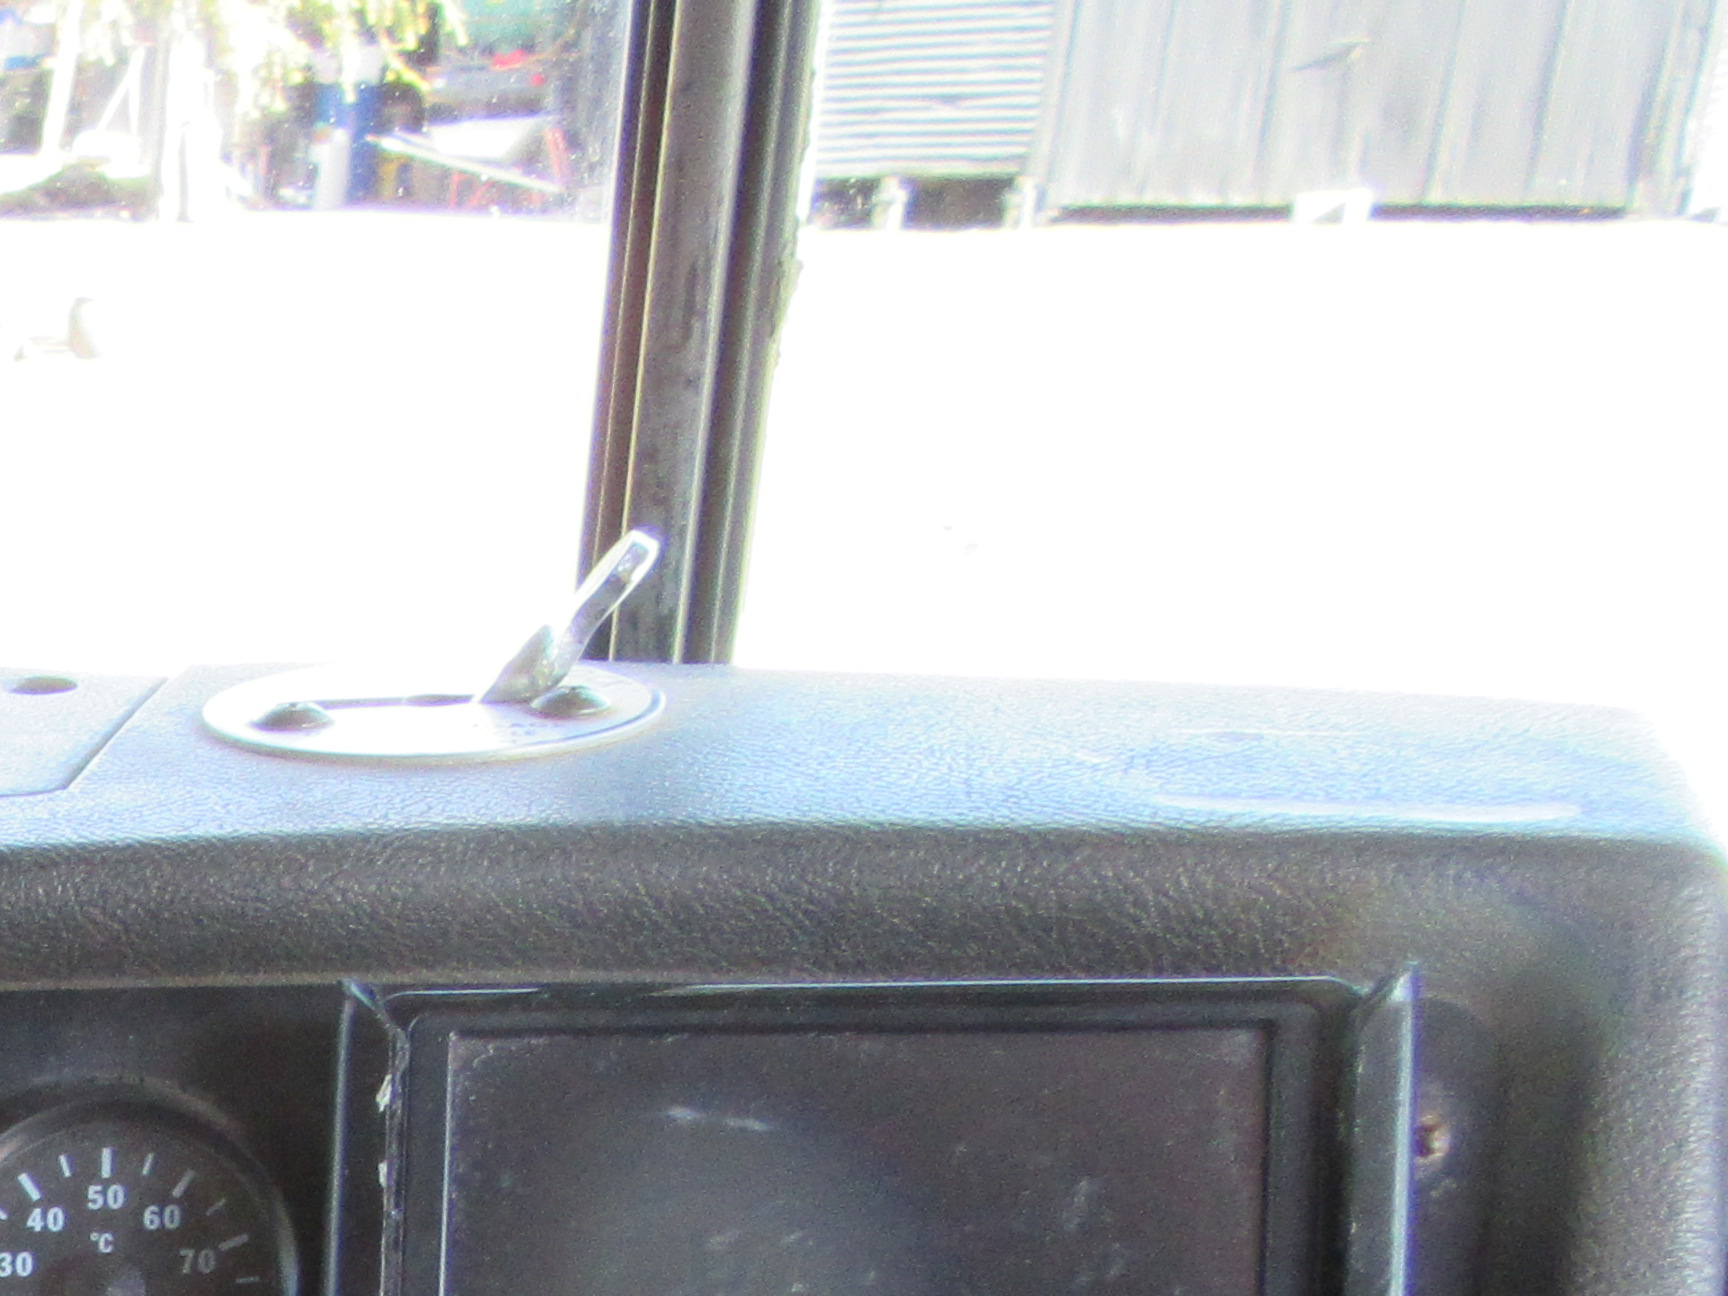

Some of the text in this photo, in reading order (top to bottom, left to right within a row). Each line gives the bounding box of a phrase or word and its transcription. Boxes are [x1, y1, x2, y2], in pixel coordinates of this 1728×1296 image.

[87, 1184, 125, 1211] 50
[26, 1206, 66, 1232] 40
[143, 1204, 181, 1231] 60
[89, 1231, 114, 1254] °C
[178, 1248, 216, 1274] 70
